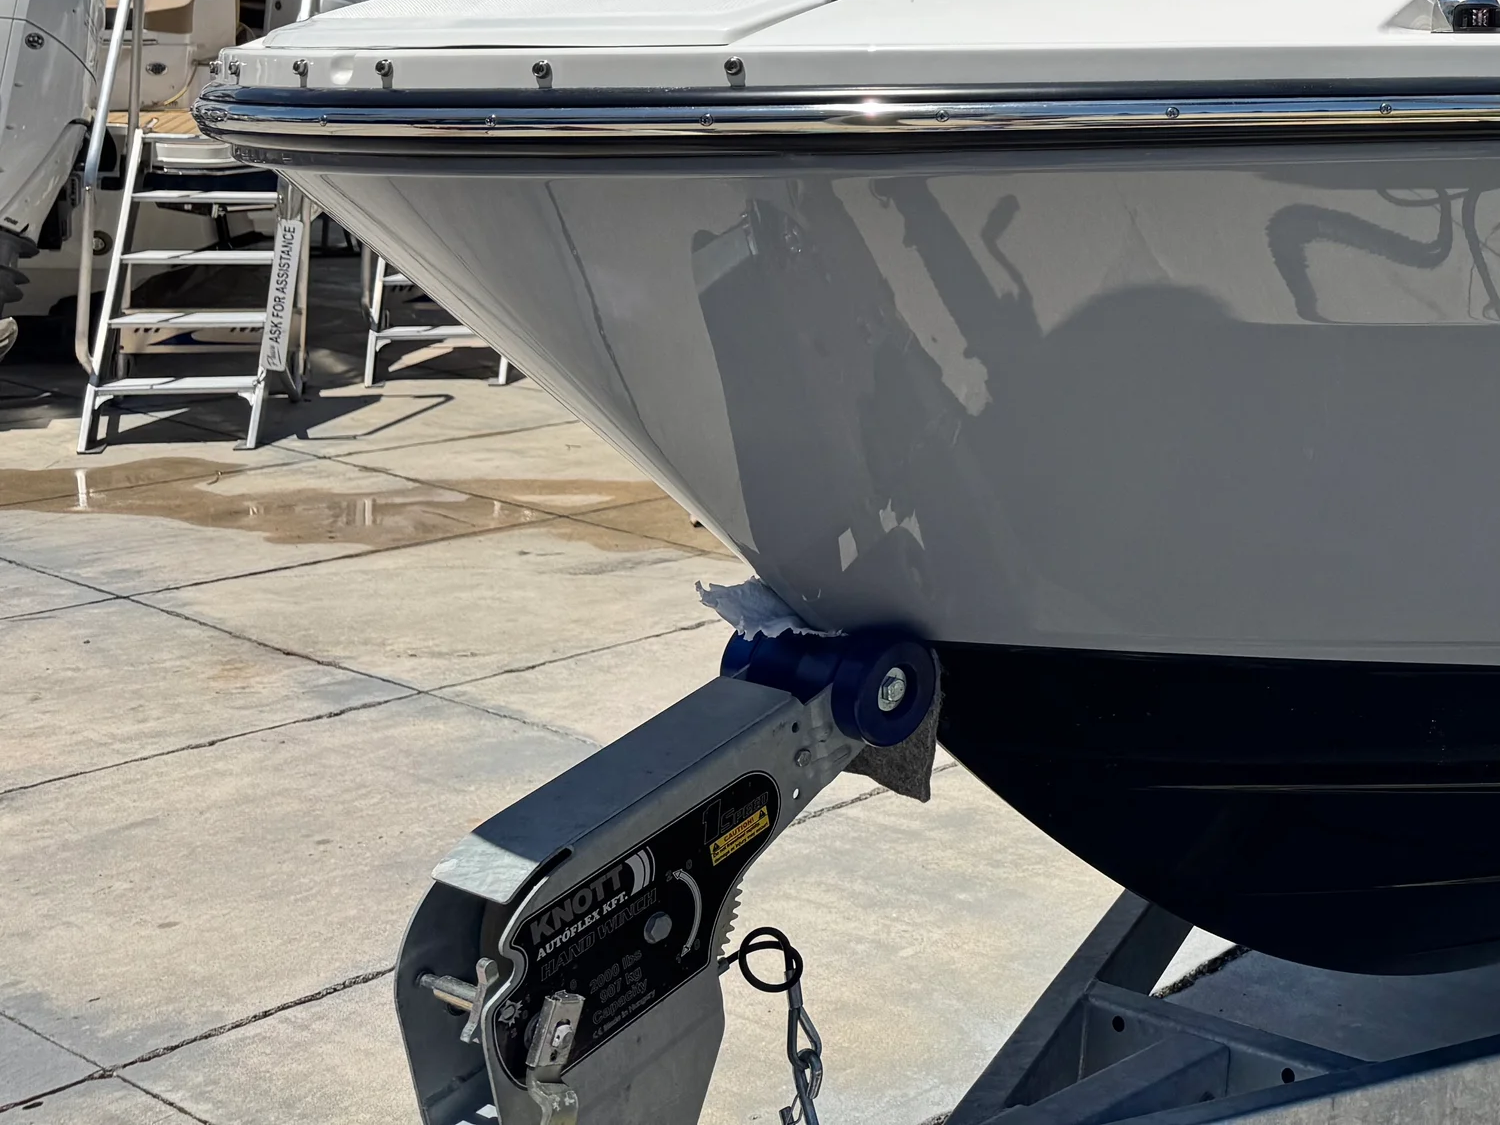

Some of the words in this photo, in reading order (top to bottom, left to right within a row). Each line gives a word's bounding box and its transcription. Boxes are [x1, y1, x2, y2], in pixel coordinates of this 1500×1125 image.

[275, 226, 296, 295] ASSISTANCE
[272, 296, 286, 320] FOR
[269, 321, 282, 344] ASK
[724, 816, 755, 842] CAUTION!
[530, 863, 625, 946] KNOTT
[537, 908, 602, 962] AUTÓFLEX
[602, 890, 629, 916] KFT.
[540, 930, 596, 982] HAND
[597, 888, 657, 940] WINCH
[588, 963, 620, 995] 2000
[621, 949, 643, 969] lbs
[599, 977, 622, 1004] 907
[625, 967, 643, 985] kg
[592, 978, 648, 1025] Capacity
